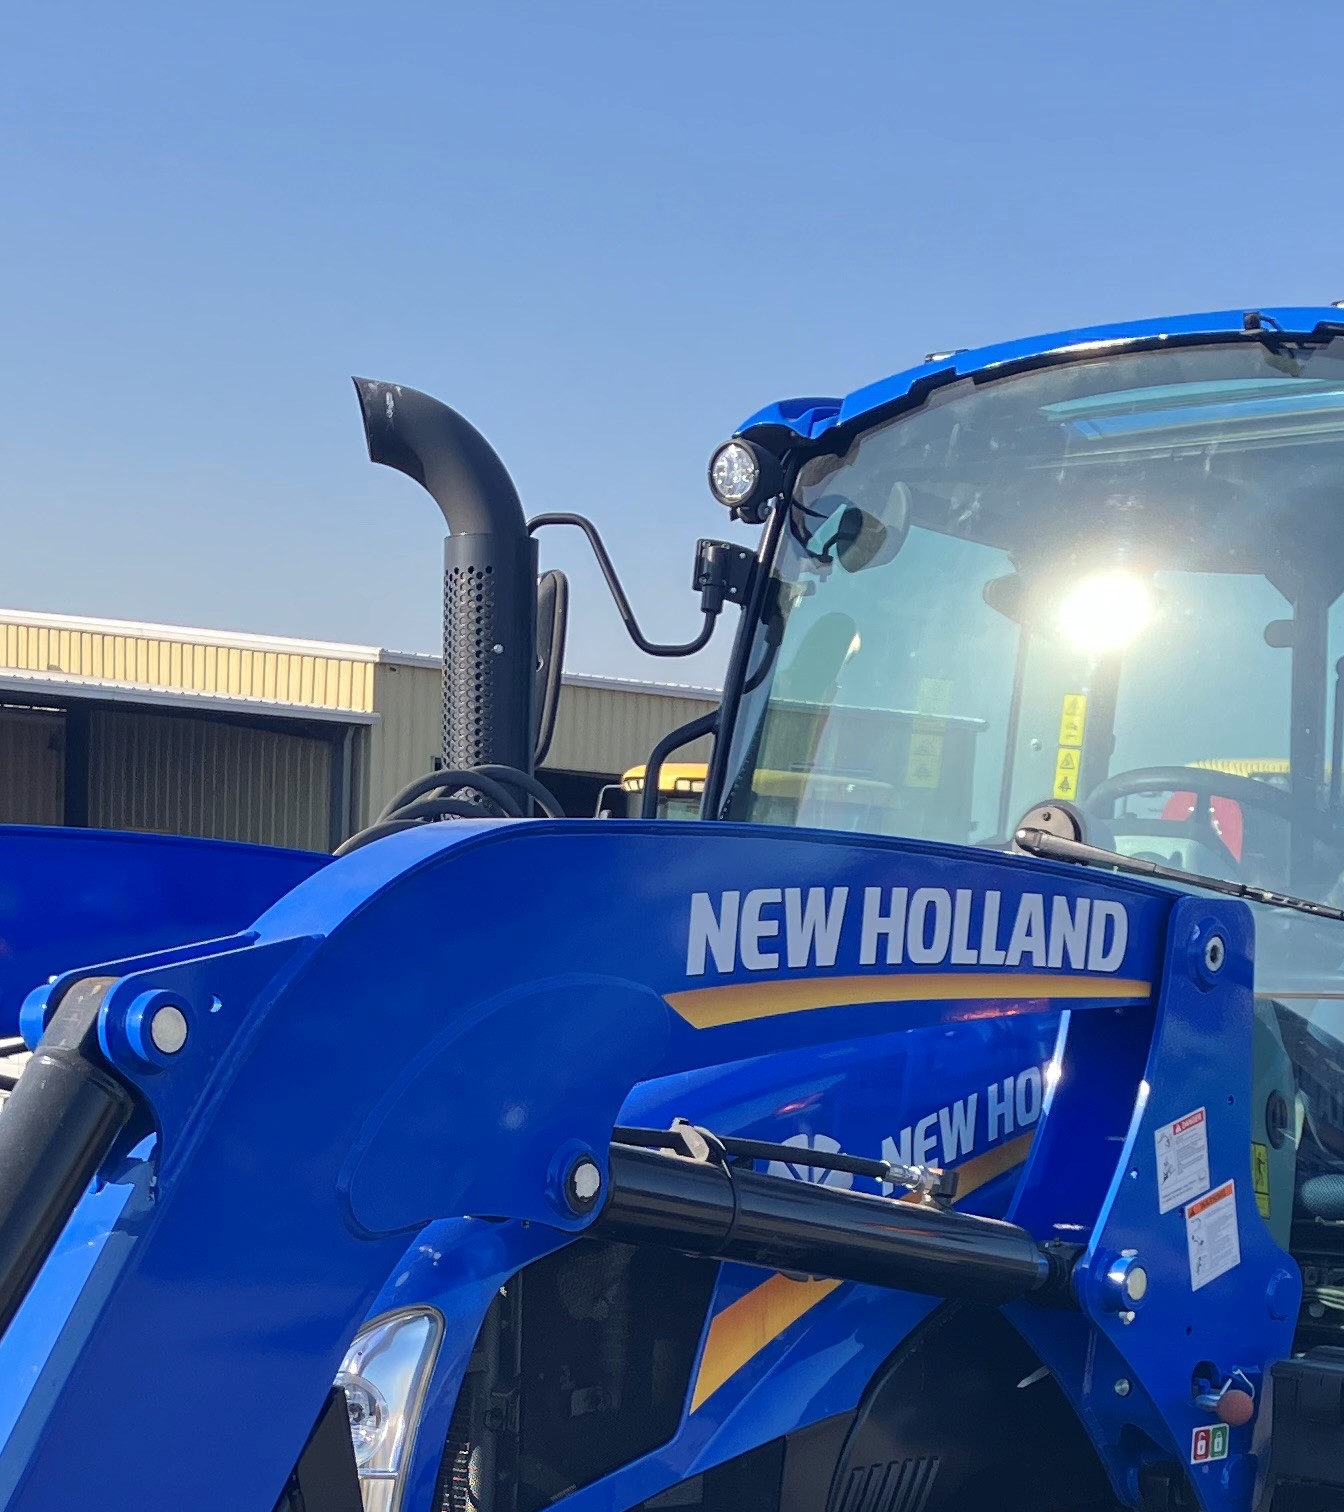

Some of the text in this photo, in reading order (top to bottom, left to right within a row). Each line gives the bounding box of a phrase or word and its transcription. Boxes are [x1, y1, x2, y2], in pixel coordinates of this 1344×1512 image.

[686, 886, 1128, 976] NEW HOLLAND
[881, 1092, 978, 1197] NEW
